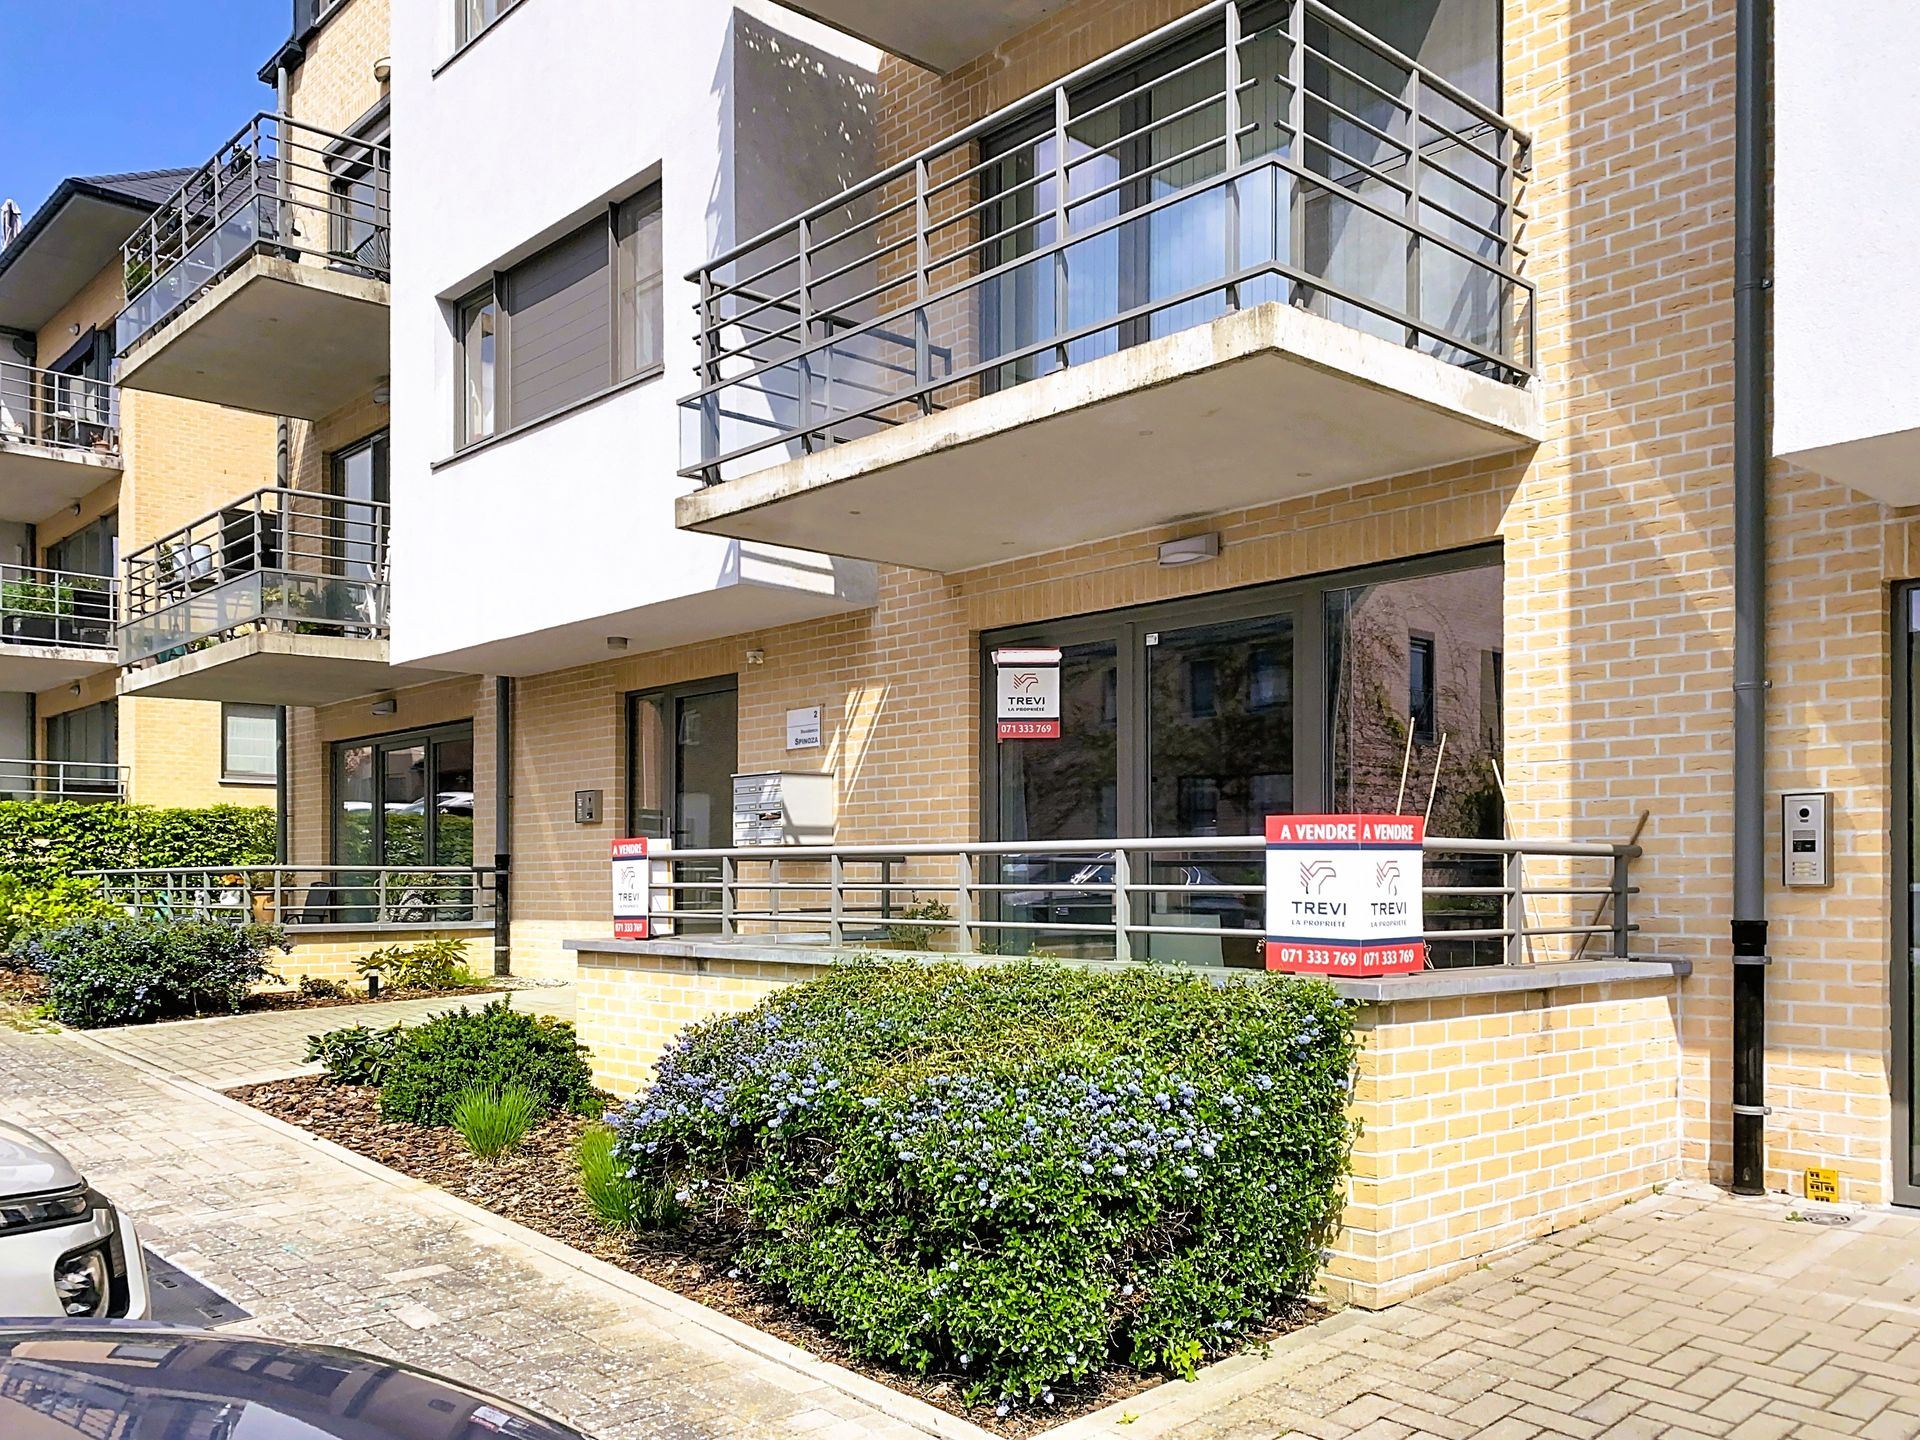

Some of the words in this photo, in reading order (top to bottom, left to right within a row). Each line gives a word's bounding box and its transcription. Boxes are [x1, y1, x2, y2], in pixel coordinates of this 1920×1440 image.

[1007, 696, 1045, 705] TREVI
[813, 710, 818, 718] 2
[1001, 724, 1016, 733] 071
[1018, 724, 1034, 733] 333
[1036, 724, 1052, 733] 769
[794, 737, 819, 745] SPINOZA
[1280, 824, 1292, 840] A
[1295, 823, 1356, 841] VENDRE
[1363, 824, 1372, 840] A
[1374, 823, 1414, 841] VENDRE
[613, 845, 619, 856] A
[619, 843, 643, 855] VENDRE
[618, 892, 640, 901] TREVI
[1291, 901, 1347, 915] TREVI
[1370, 902, 1407, 915] TREVI
[1281, 948, 1302, 963] 071
[1306, 949, 1330, 964] 333
[1333, 950, 1357, 967] 769
[1363, 951, 1380, 967] 071
[1382, 950, 1397, 965] 333
[1399, 948, 1414, 963] 769
